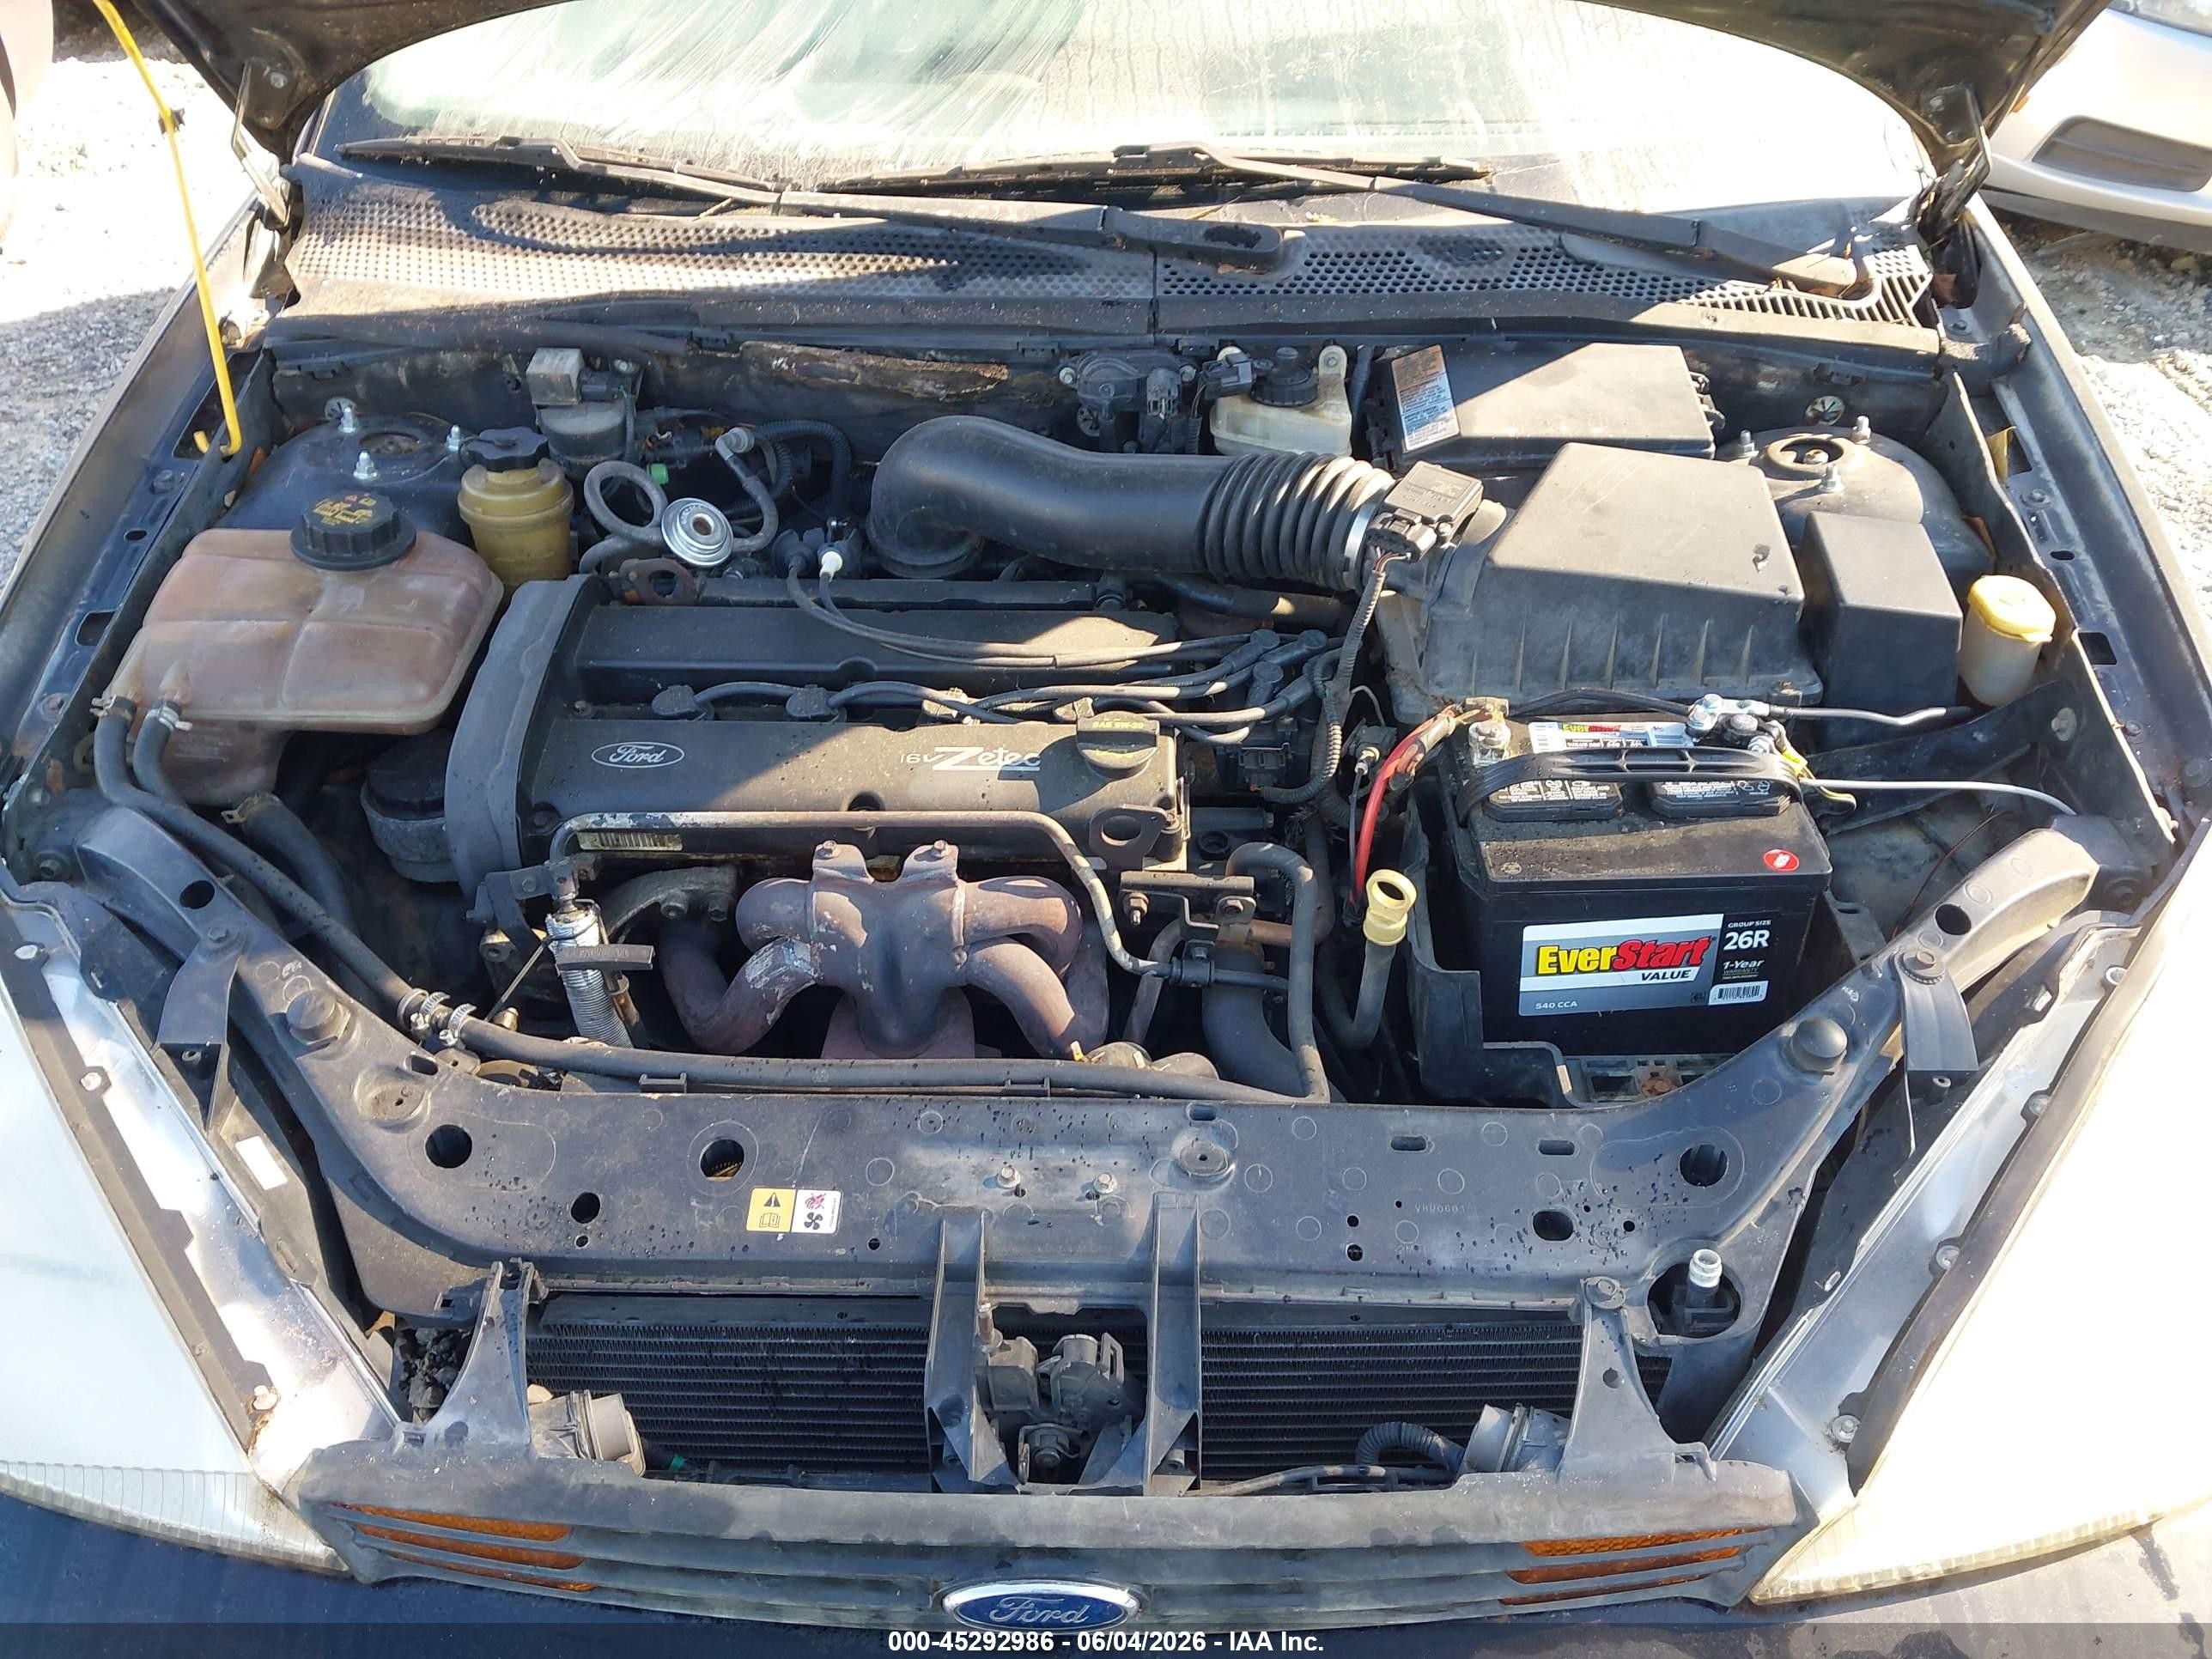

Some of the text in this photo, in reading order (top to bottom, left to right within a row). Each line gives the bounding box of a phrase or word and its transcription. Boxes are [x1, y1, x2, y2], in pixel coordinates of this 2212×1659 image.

[609, 744, 667, 763] Ford
[933, 746, 1041, 771] Zetec
[1723, 930, 1770, 951] 26R
[1536, 936, 1712, 976] EverStart
[1723, 959, 1765, 970] 1-Year
[1641, 969, 1692, 981] VALUE
[989, 1595, 1090, 1625] Ford
